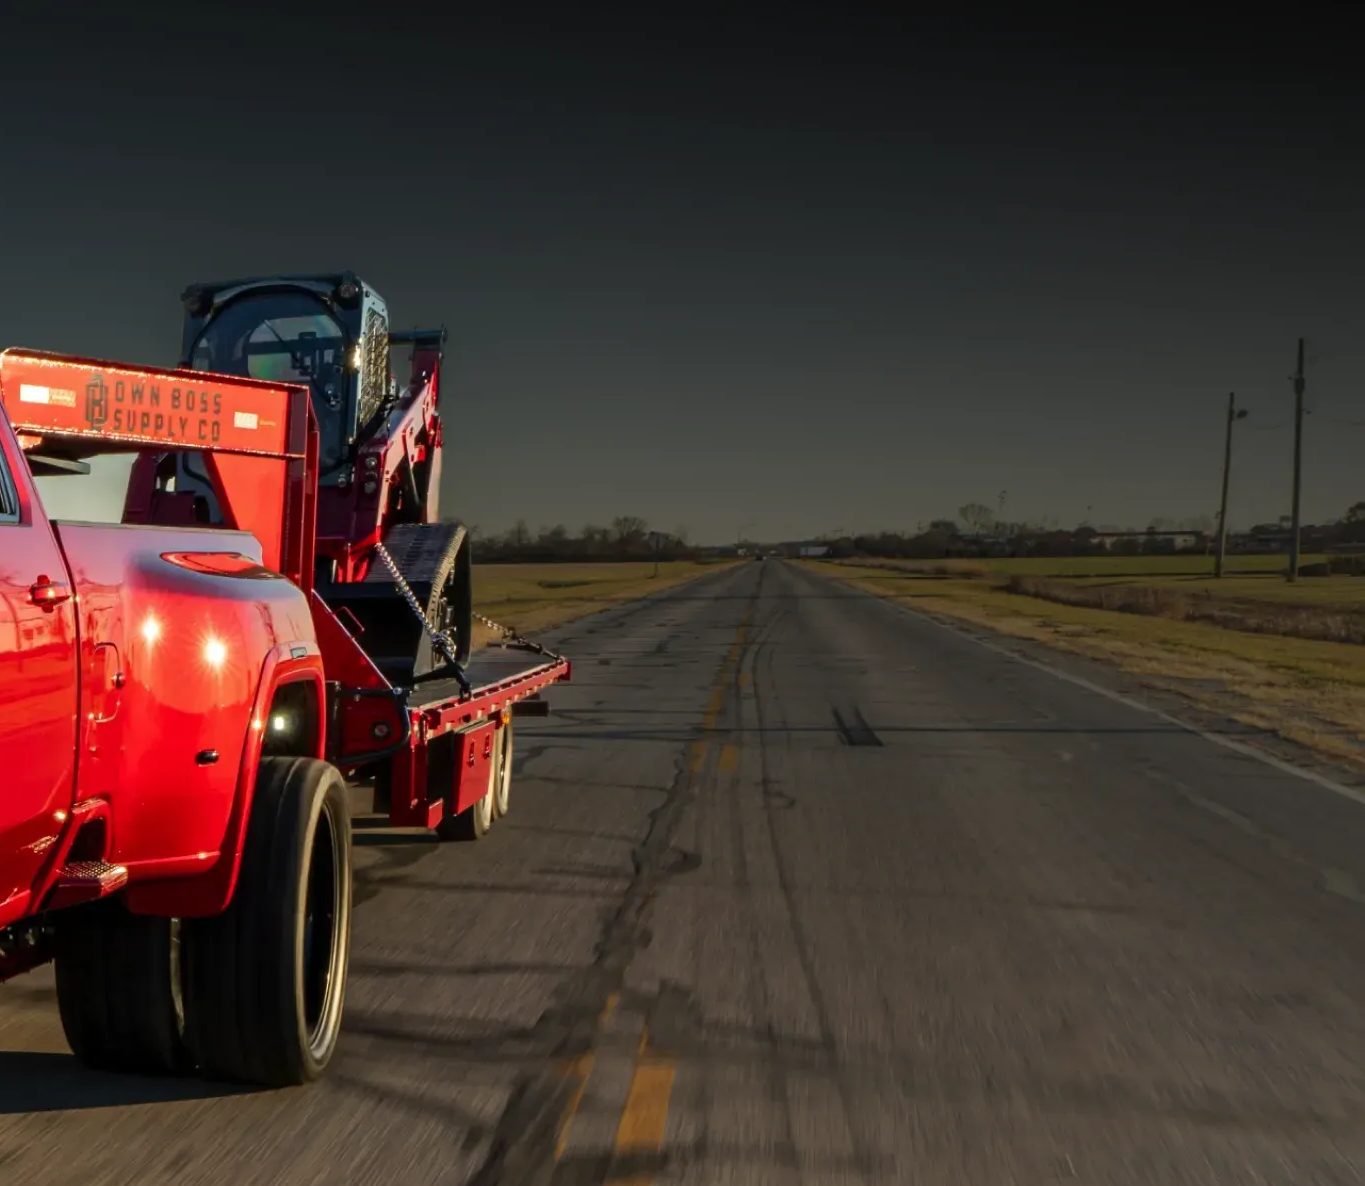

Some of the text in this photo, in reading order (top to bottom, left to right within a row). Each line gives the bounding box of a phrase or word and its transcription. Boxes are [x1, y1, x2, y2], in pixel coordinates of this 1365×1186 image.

[114, 380, 161, 408] OWN
[171, 387, 223, 415] BOSS
[113, 409, 221, 443] SUPPLY CO
